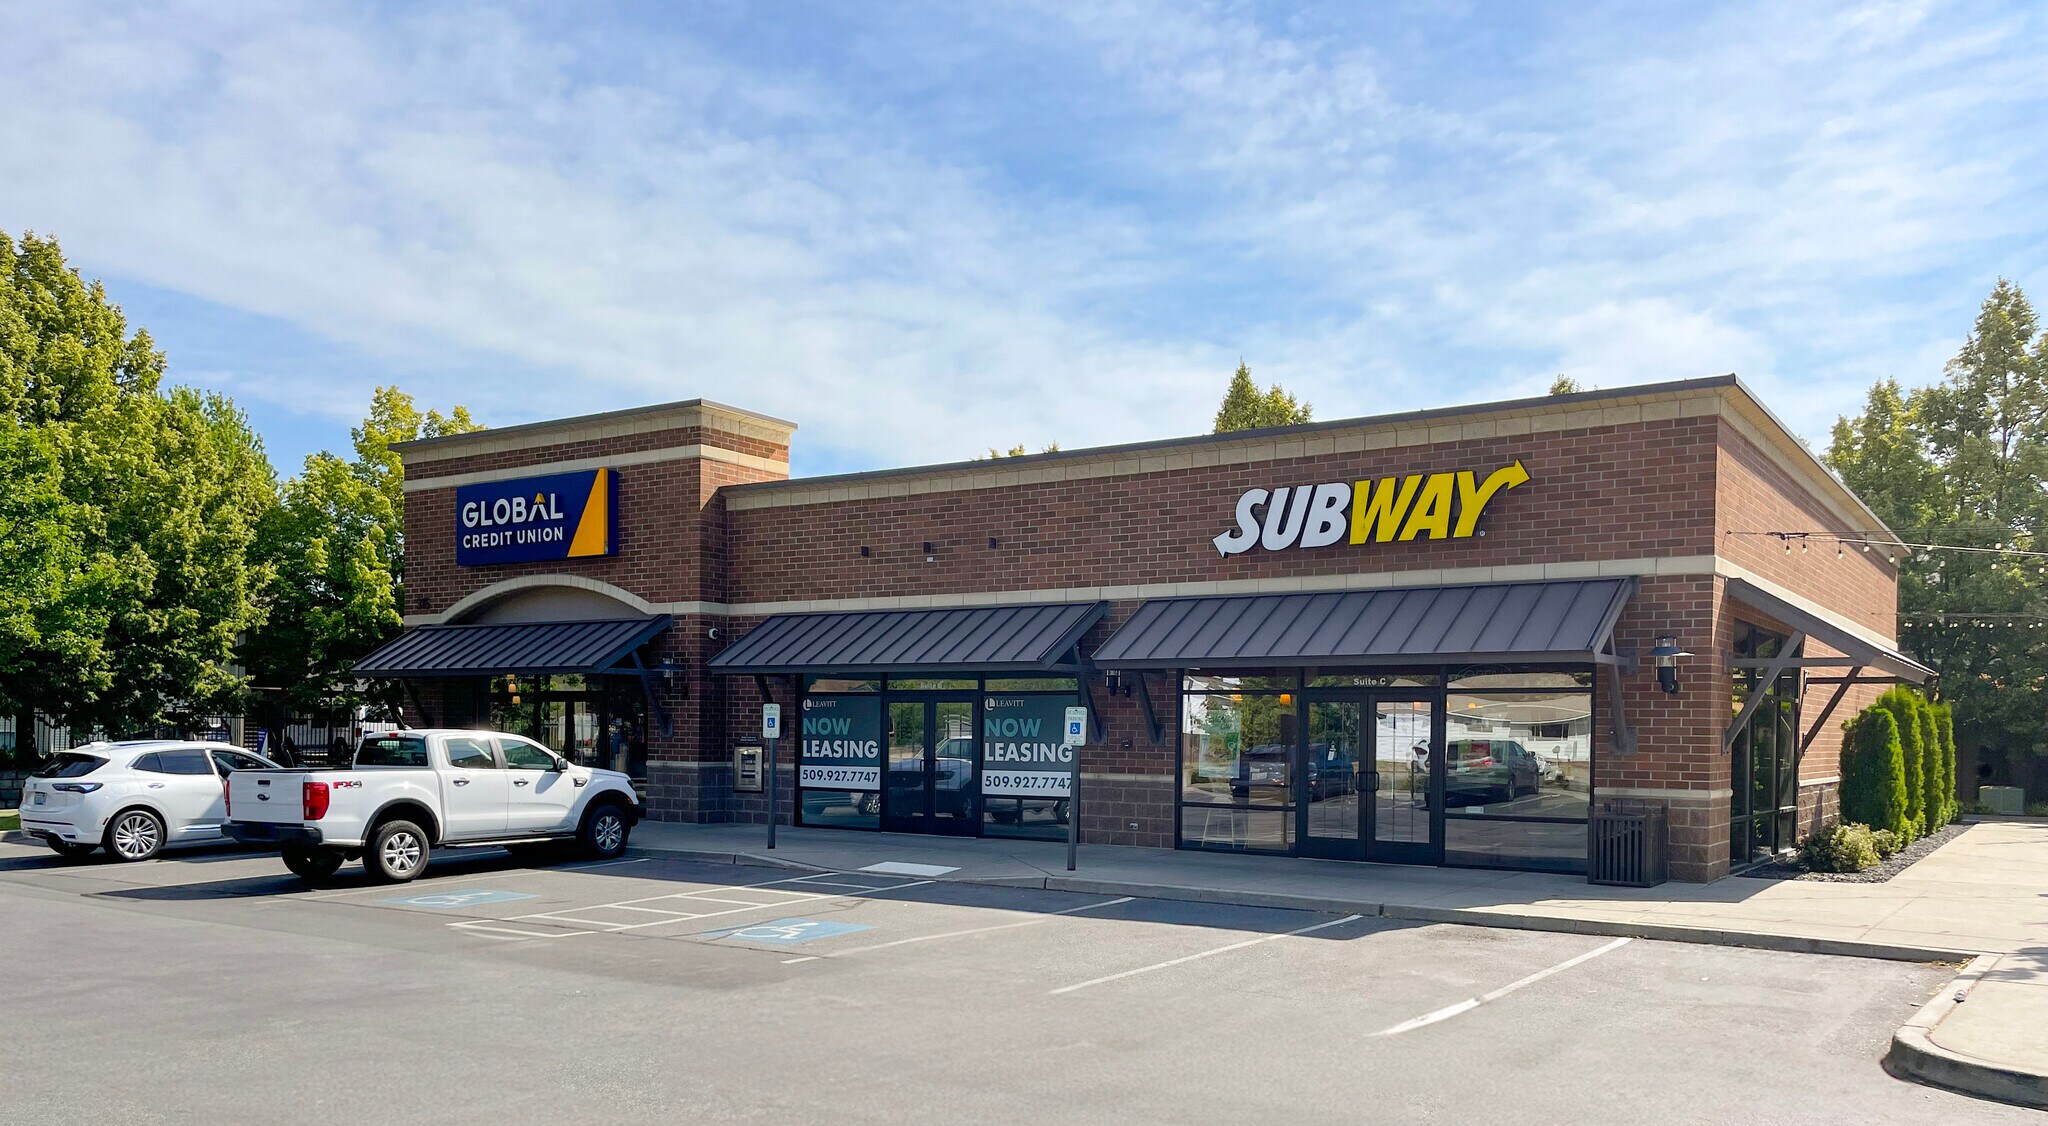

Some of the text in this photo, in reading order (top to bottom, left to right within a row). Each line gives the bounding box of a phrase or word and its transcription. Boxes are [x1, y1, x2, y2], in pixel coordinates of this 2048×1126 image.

[462, 492, 564, 528] GLOBAL
[1211, 458, 1531, 558] SUBWAY
[463, 526, 563, 549] CREDIT UNION
[1353, 677, 1386, 686] Suite C
[812, 700, 837, 708] LEAVITT
[995, 699, 1025, 707] LEAVITT
[803, 717, 852, 736] NOW
[984, 717, 1042, 738] NOW
[803, 740, 879, 759] LEASING
[984, 742, 1073, 763] LEASING
[802, 769, 878, 783] 509.927.7747
